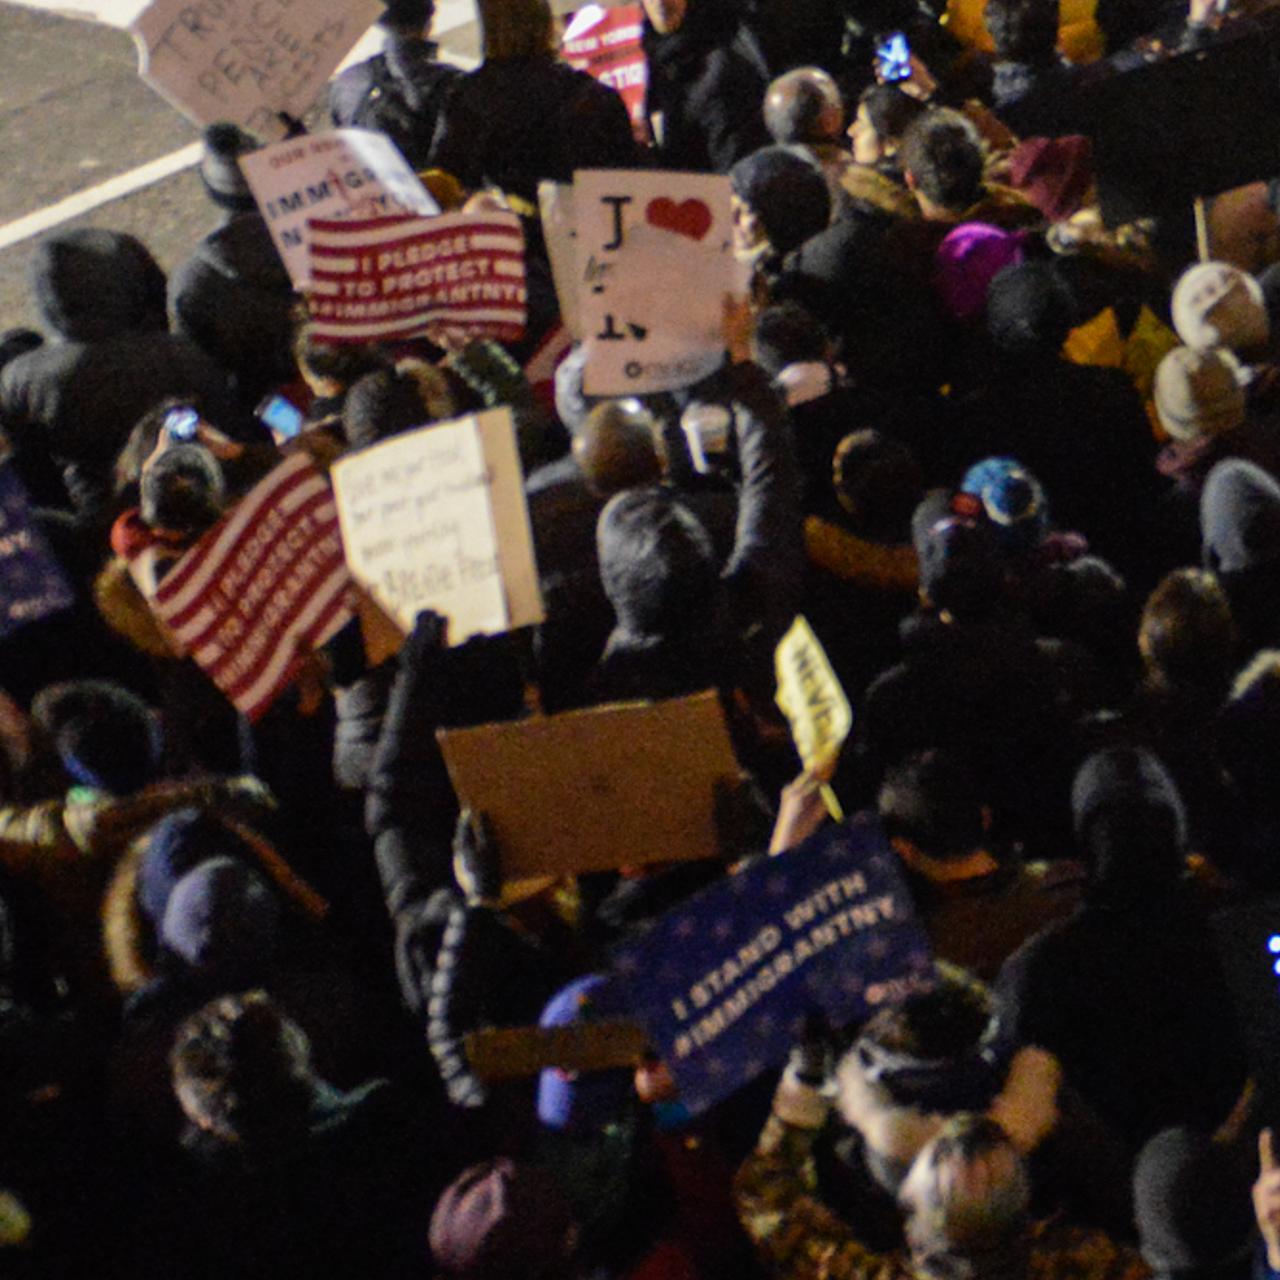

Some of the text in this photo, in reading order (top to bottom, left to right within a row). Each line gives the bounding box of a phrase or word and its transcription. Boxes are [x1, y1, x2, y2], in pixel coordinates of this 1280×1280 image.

[345, 259, 490, 297] TO PROTECT
[379, 234, 470, 268] PLEDGE
[219, 507, 286, 597] PLEDGE
[238, 517, 315, 620] PROTECT
[672, 871, 867, 1021] I STAND WITH
[672, 894, 896, 1059] #IMMIGRANTNY
